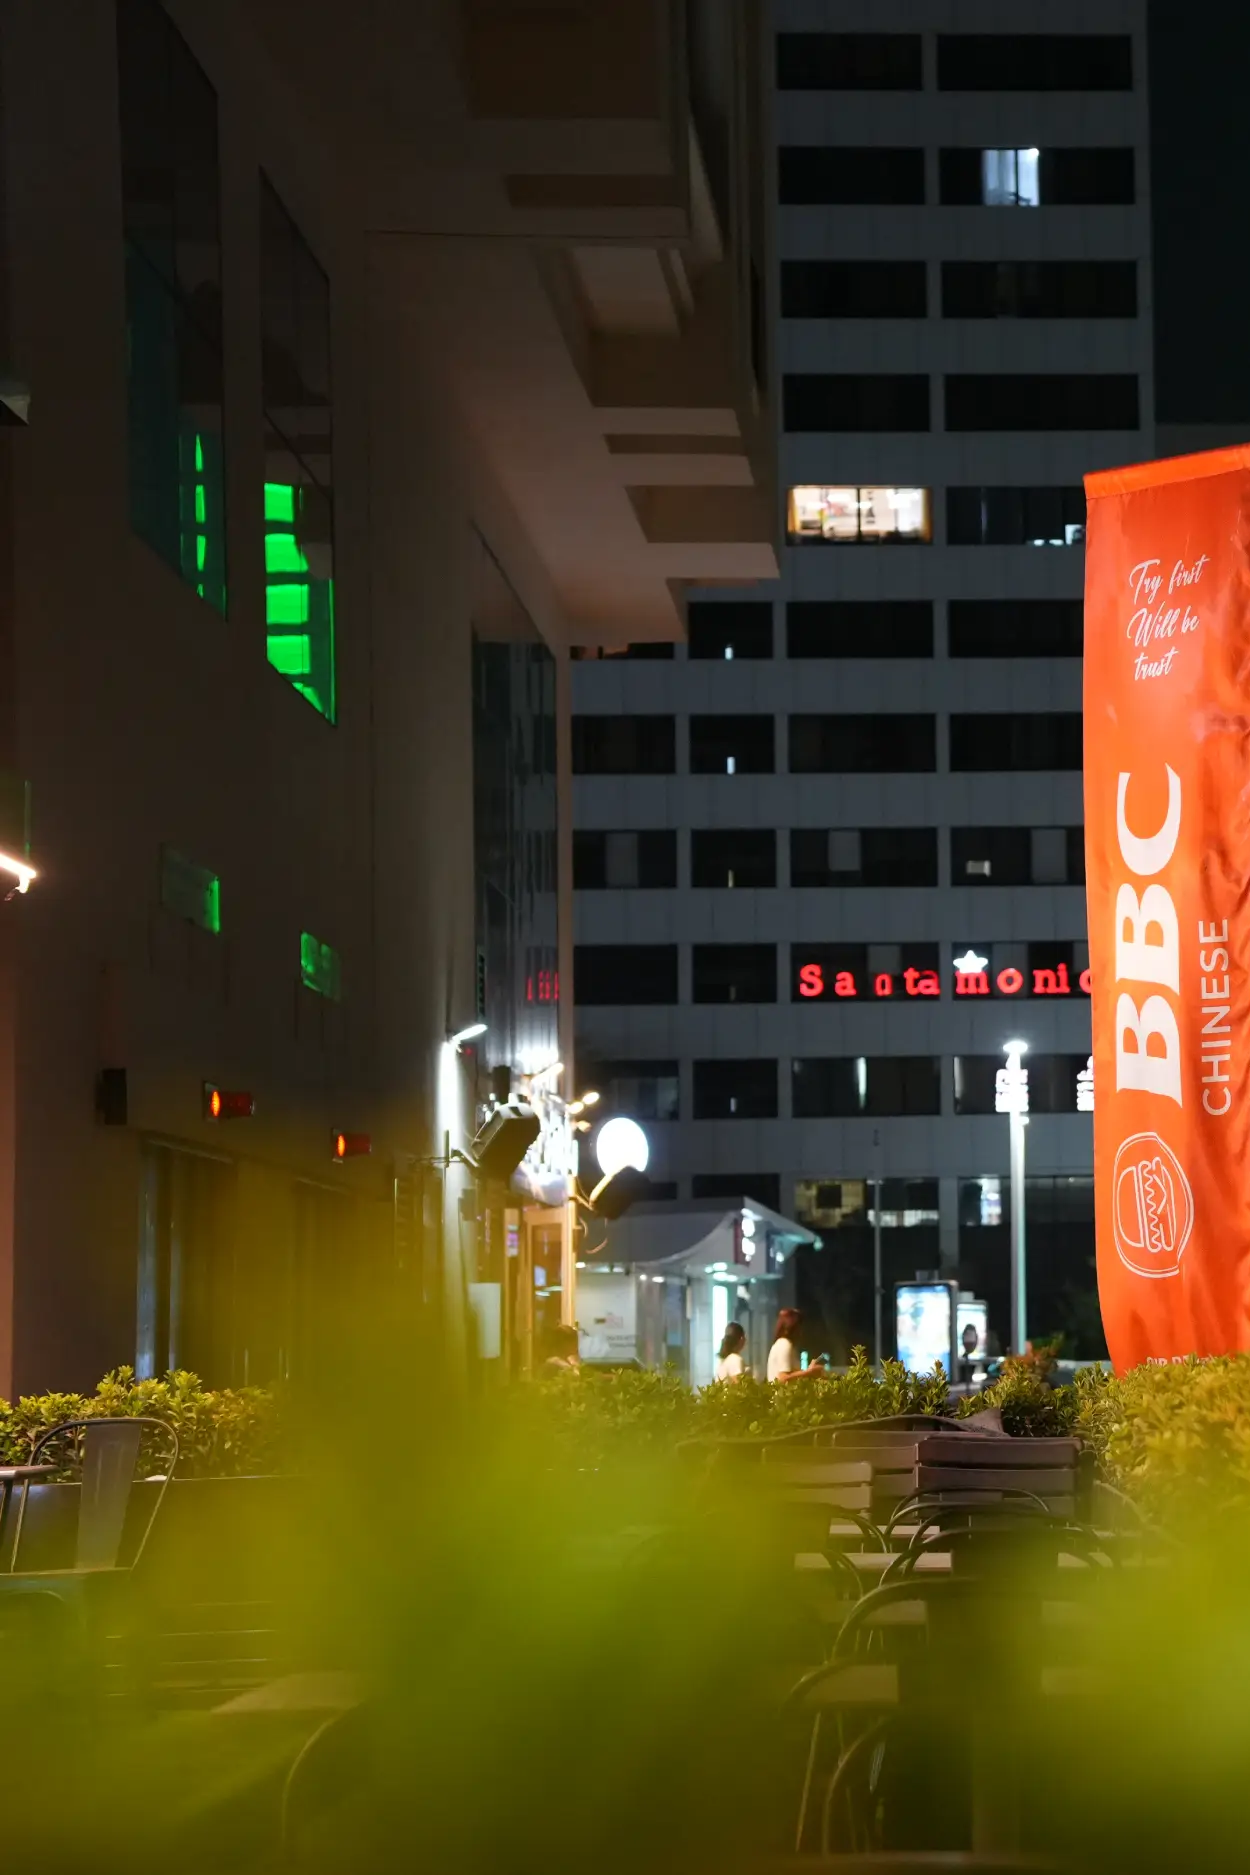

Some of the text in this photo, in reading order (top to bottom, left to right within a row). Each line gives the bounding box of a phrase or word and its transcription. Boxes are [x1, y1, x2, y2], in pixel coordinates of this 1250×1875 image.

[1129, 554, 1210, 605] Try first
[1127, 601, 1200, 648] Will be
[1134, 646, 1179, 681] trust
[1115, 762, 1183, 1109] BBC
[1198, 918, 1232, 1116] CHINESE
